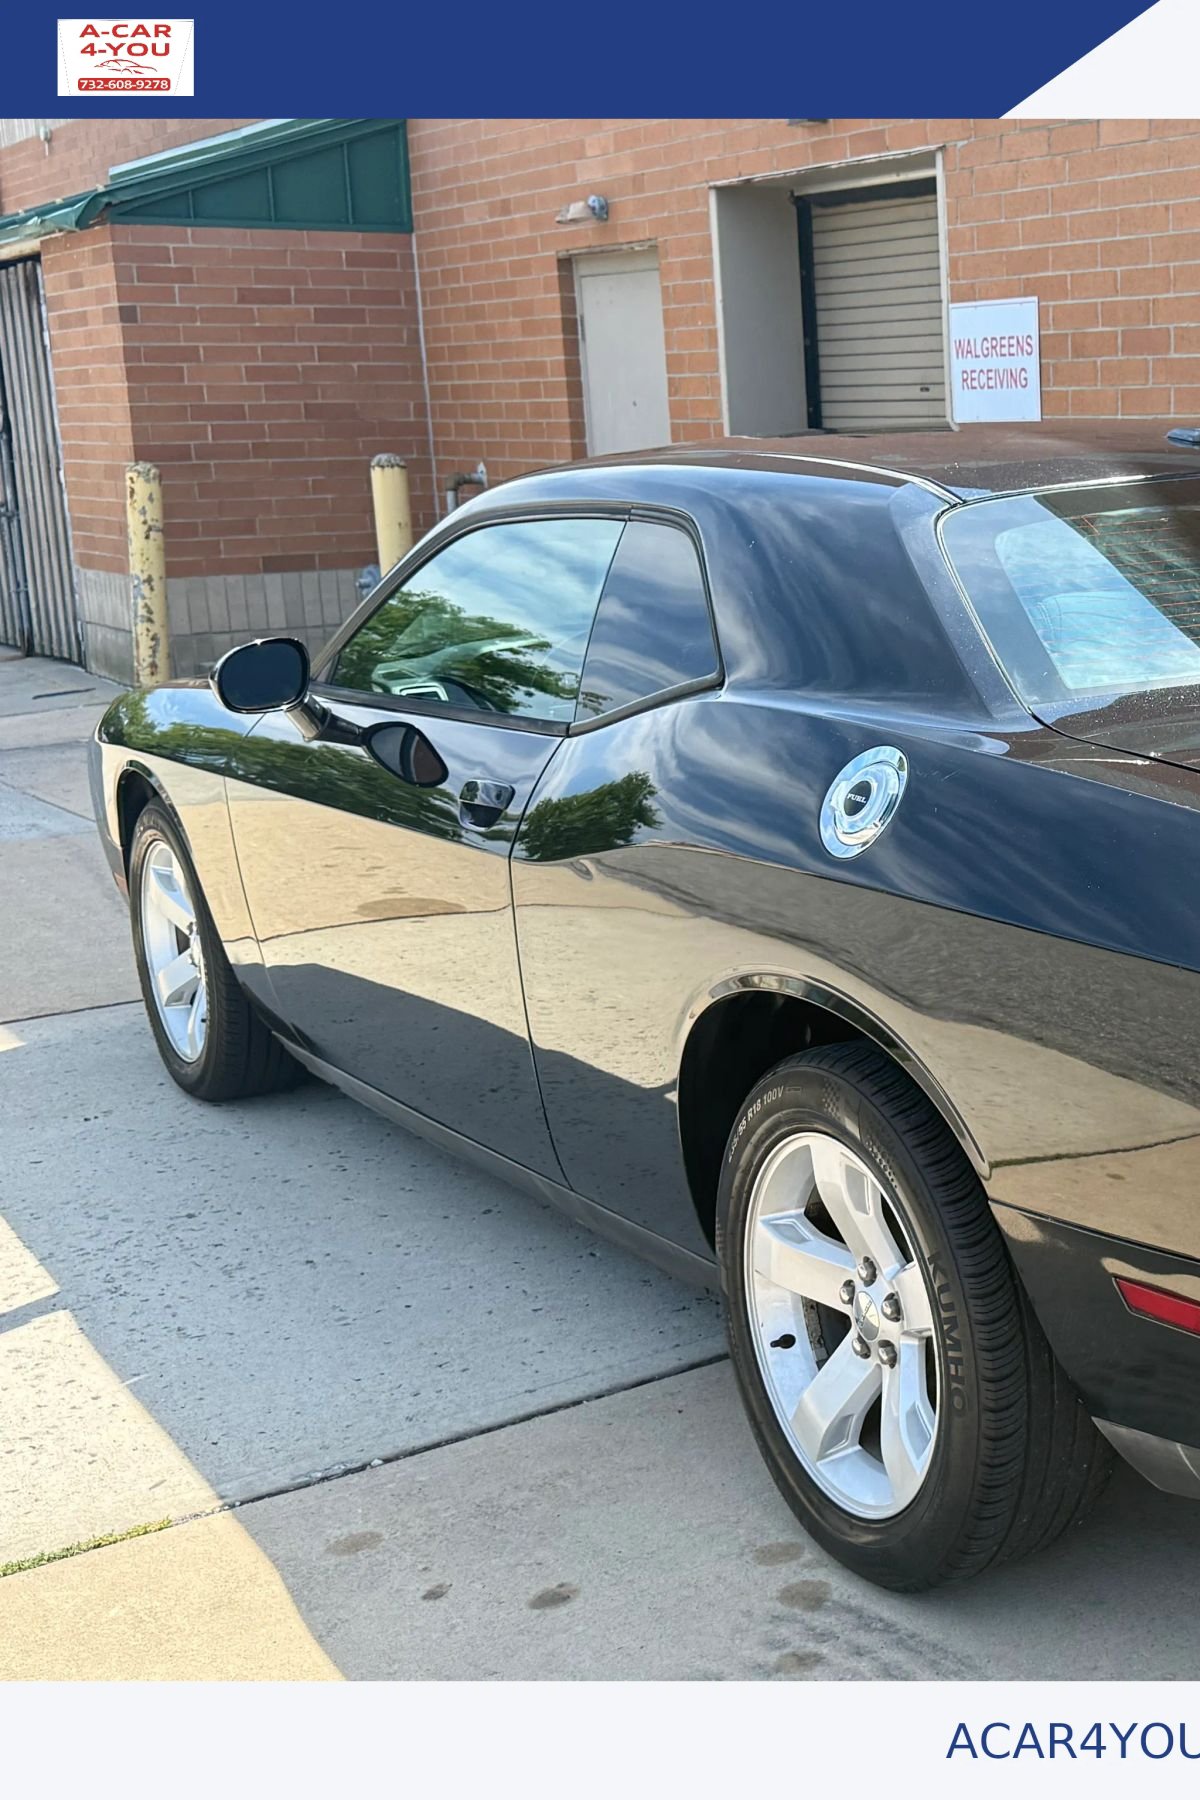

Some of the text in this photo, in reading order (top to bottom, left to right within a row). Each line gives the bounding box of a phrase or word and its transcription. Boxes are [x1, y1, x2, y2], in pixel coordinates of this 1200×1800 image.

[954, 334, 1034, 360] WALGREENS
[962, 367, 1029, 391] RECEIVING
[847, 793, 867, 804] FUEL
[747, 1098, 762, 1122] R18
[763, 1085, 785, 1105] 100V
[927, 1251, 967, 1418] KUMHO
